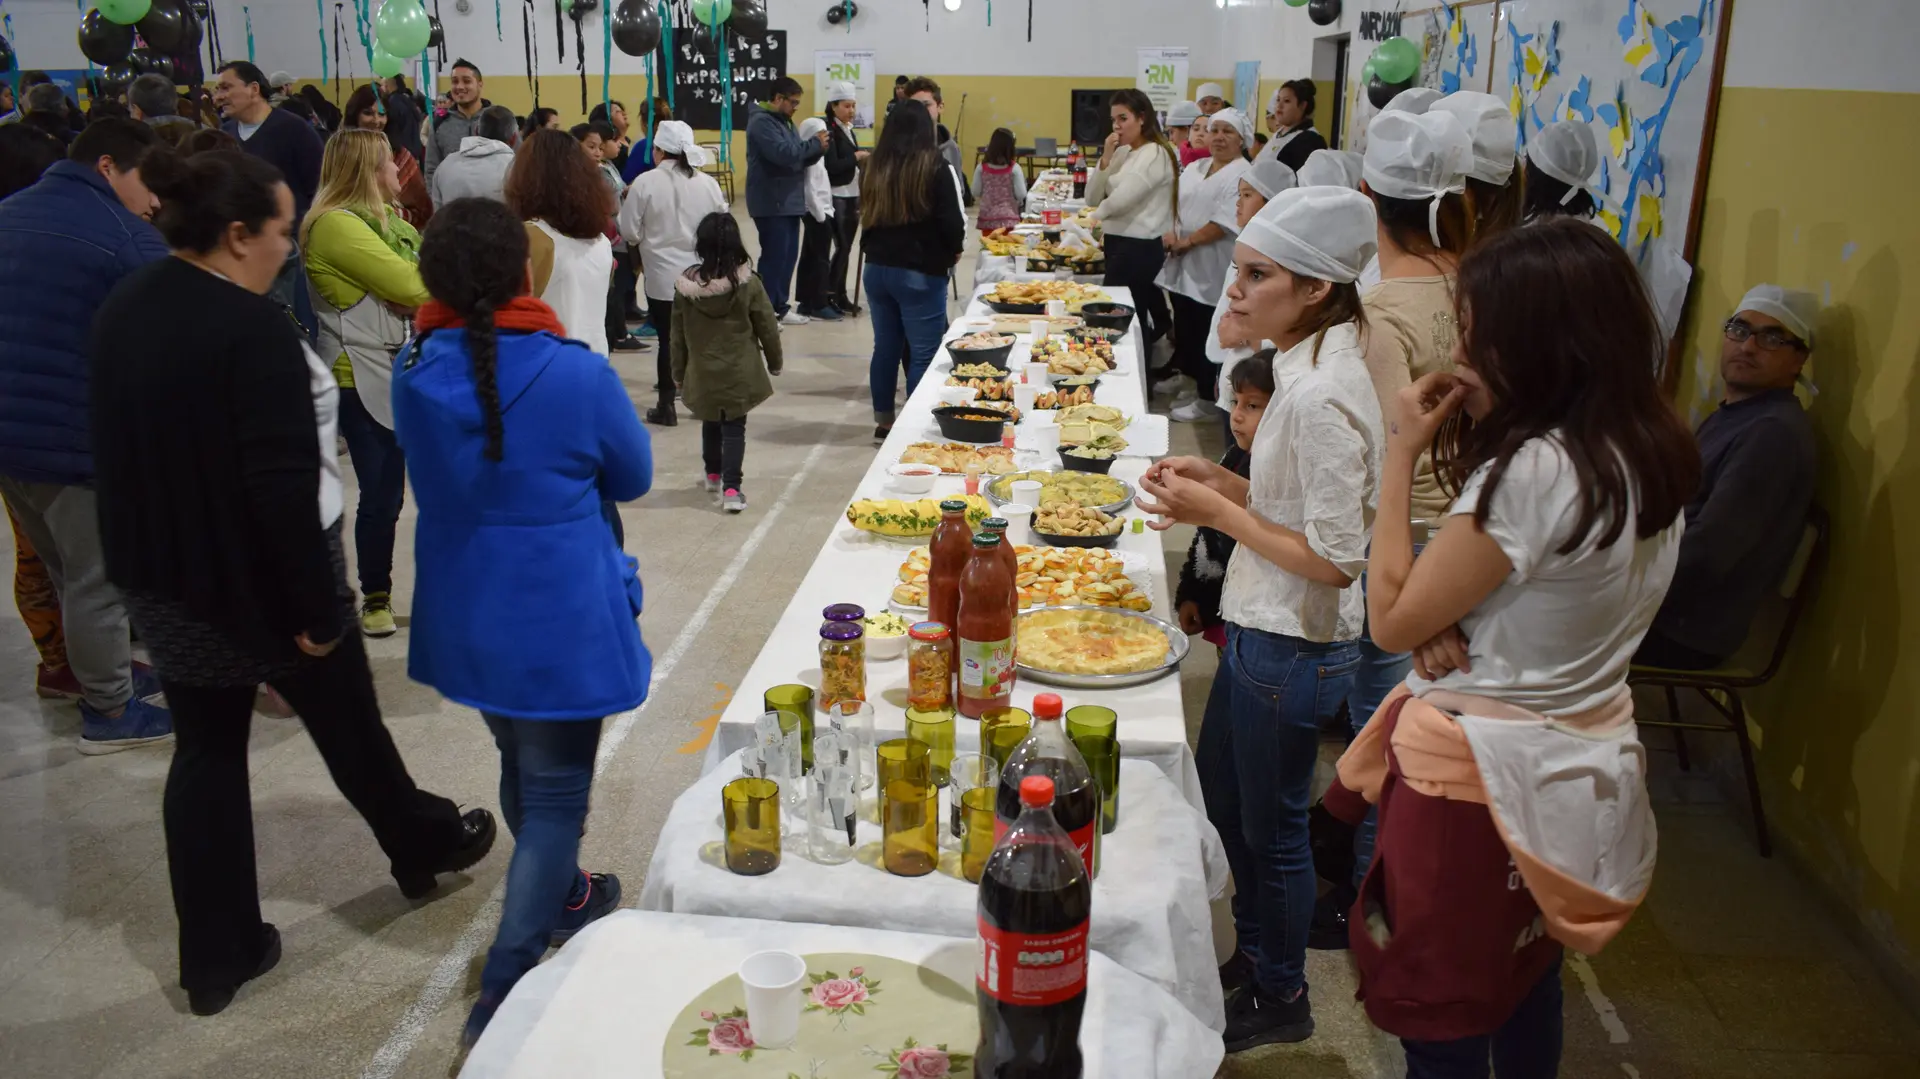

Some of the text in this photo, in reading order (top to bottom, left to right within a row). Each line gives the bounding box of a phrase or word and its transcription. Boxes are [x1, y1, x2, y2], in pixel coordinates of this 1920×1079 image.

[681, 35, 778, 65] TAERES
[675, 66, 778, 85] EMPRNDER
[829, 63, 860, 80] RN
[1147, 64, 1175, 84] RN
